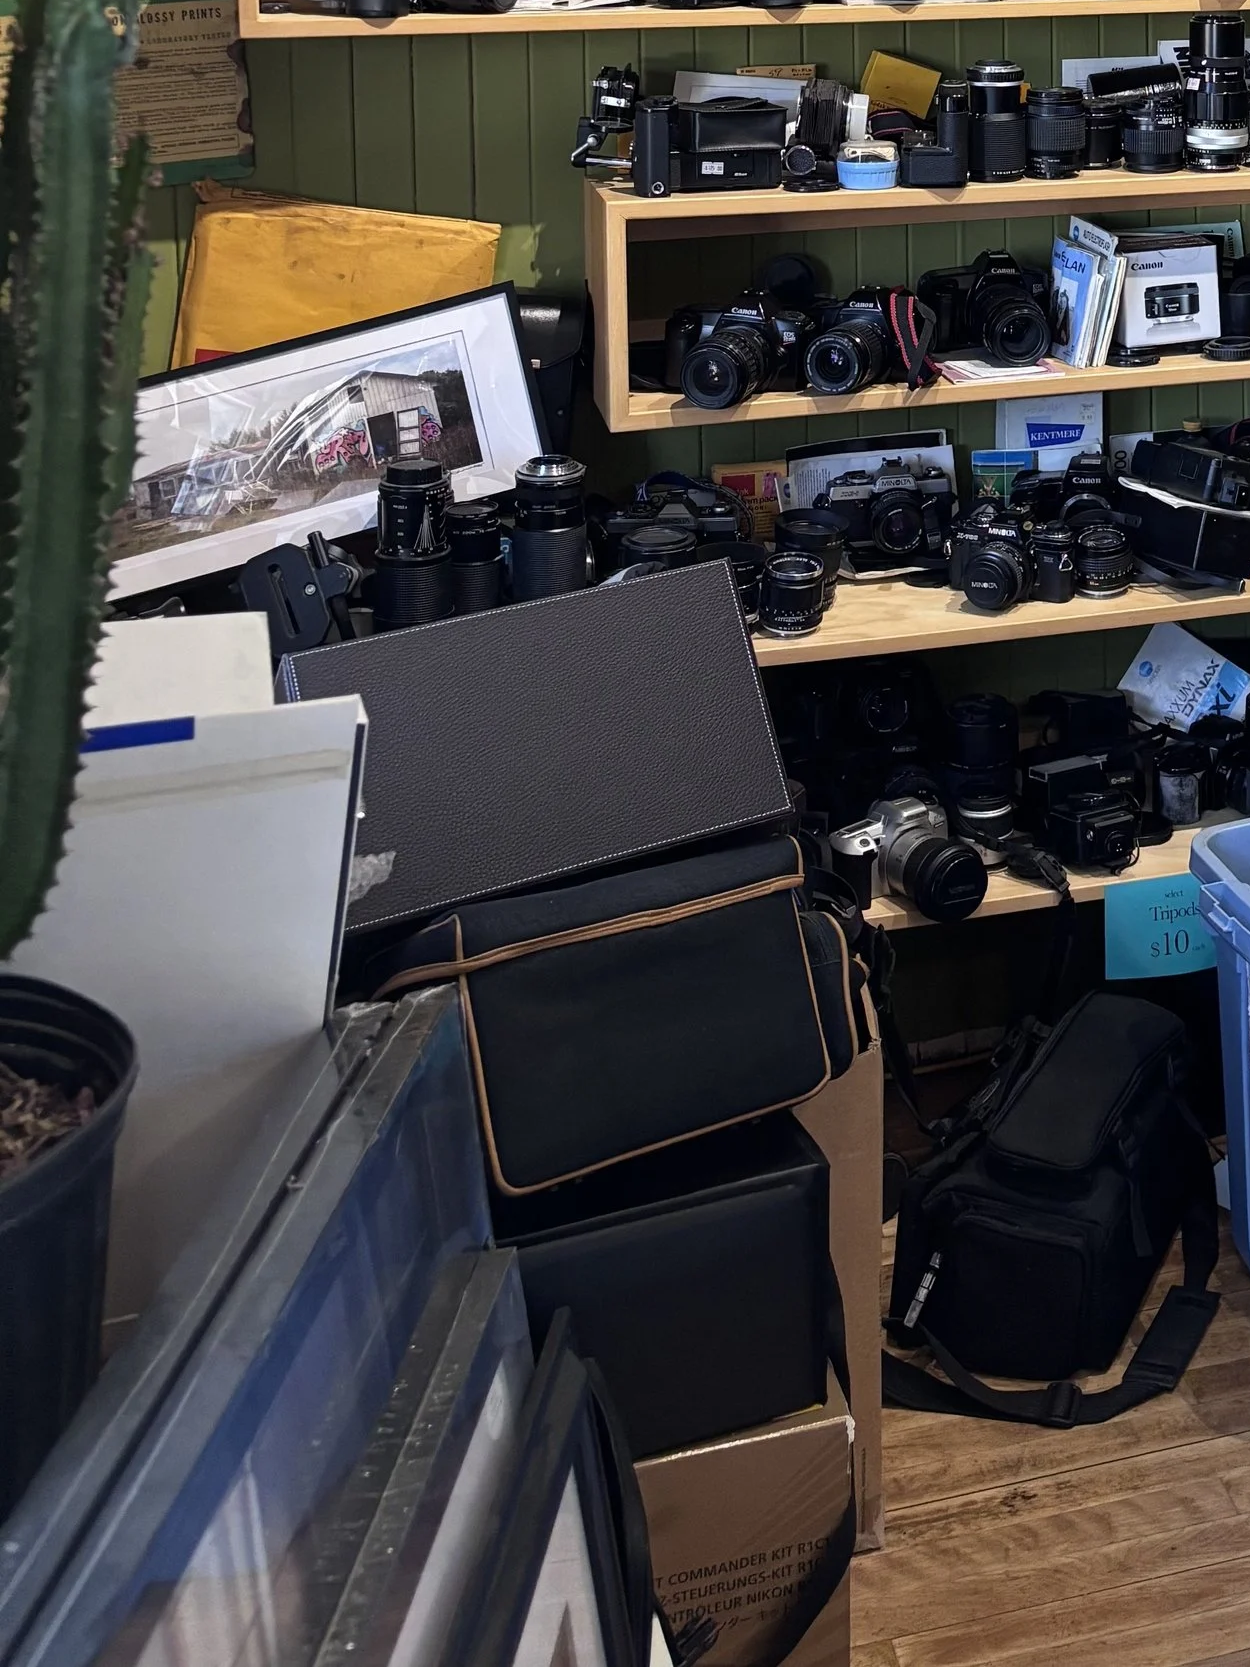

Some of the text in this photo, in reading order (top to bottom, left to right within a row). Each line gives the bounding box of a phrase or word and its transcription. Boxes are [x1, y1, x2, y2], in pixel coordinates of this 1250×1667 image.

[138, 9, 175, 25] LOSSY
[181, 7, 222, 23] PRINTS
[1227, 227, 1235, 258] Canon
[1061, 251, 1087, 275] ELAN
[1130, 261, 1163, 272] Canon
[991, 267, 1016, 275] Canon
[731, 307, 757, 316] Canon
[849, 301, 874, 309] Canon
[1029, 428, 1082, 441] KENTMERE
[881, 478, 912, 487] MINOLTA
[1072, 477, 1101, 485] Canon
[988, 527, 1017, 538] MINOLTA
[971, 581, 998, 589] MINOLTA
[1181, 658, 1220, 718] DYNAX
[1165, 890, 1184, 899] select
[1149, 902, 1201, 924] Tripods
[1150, 929, 1189, 958] $10
[668, 1552, 767, 1586] COMMANDER
[771, 1545, 794, 1562] KIT
[659, 1565, 794, 1607] Z-STEUERUNGS-KIT
[747, 1584, 794, 1607] NIKON
